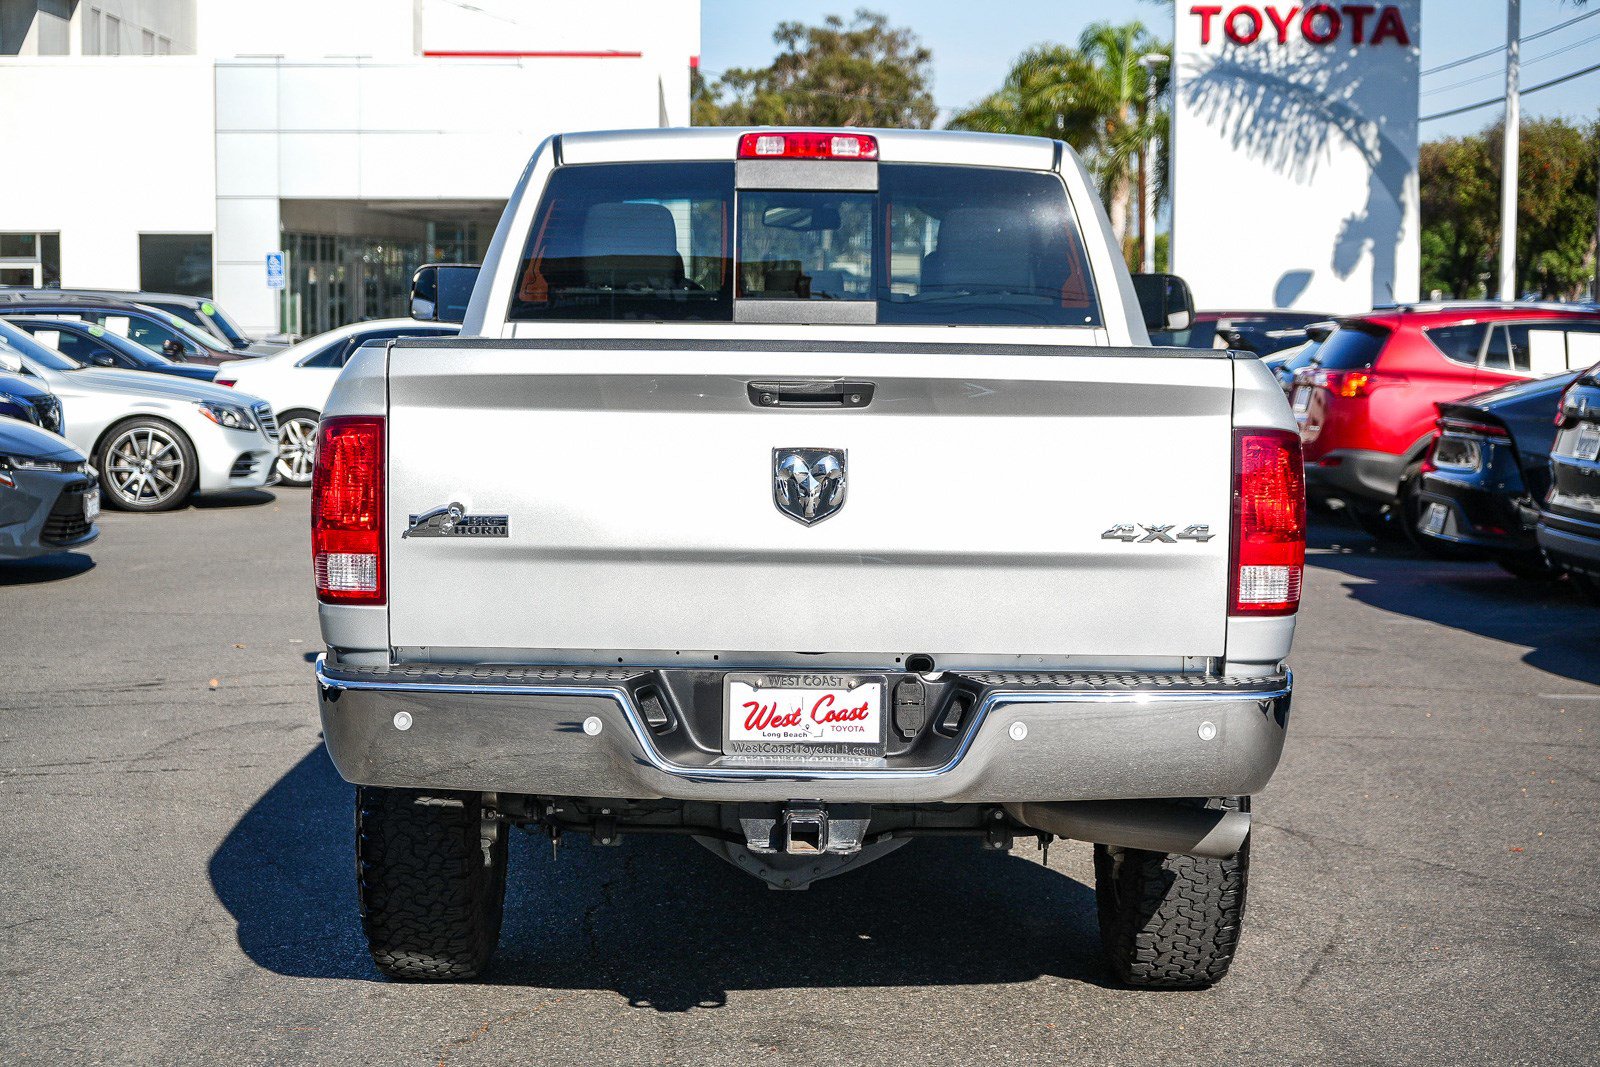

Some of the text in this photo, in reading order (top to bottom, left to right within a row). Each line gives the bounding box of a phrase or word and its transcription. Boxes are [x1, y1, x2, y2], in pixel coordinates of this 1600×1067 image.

[1189, 5, 1410, 45] TOYOTA
[467, 516, 498, 526] BIG
[454, 526, 506, 535] HORN
[769, 674, 843, 687] WEST COAST
[742, 693, 869, 731] West Coast
[831, 725, 865, 733] TOYOTA
[762, 731, 781, 739] Long
[732, 743, 878, 757] WestCoastToyotaLB.com
